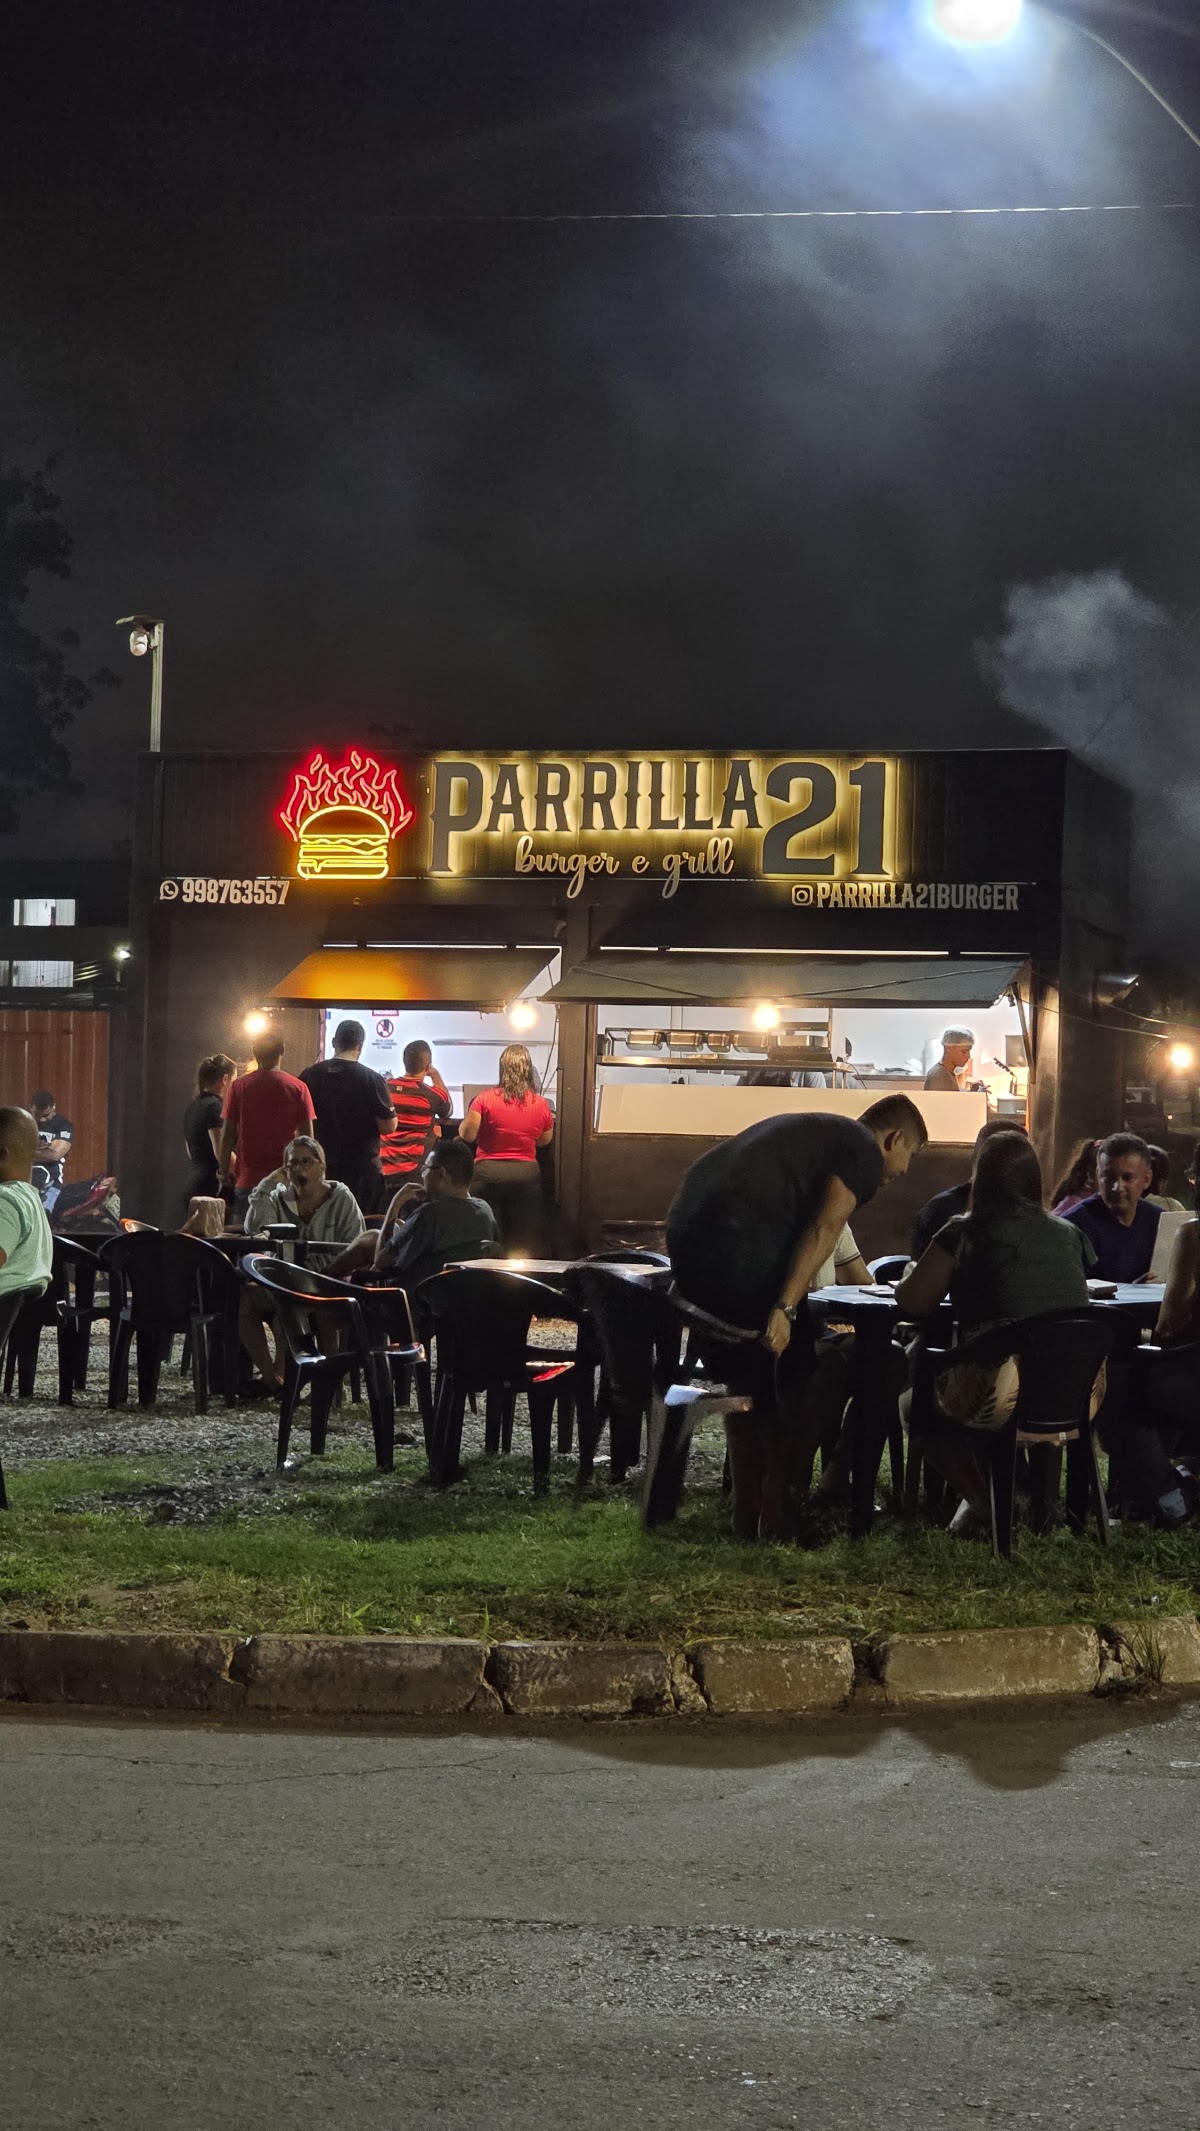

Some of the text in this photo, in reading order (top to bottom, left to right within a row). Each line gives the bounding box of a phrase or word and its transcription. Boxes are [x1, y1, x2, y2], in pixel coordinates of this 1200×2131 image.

[429, 759, 891, 876] PARRILLA 21
[514, 834, 735, 899] burger e grill
[182, 879, 290, 905] 998763557
[816, 881, 1019, 911] PARRILLA21BURGER
